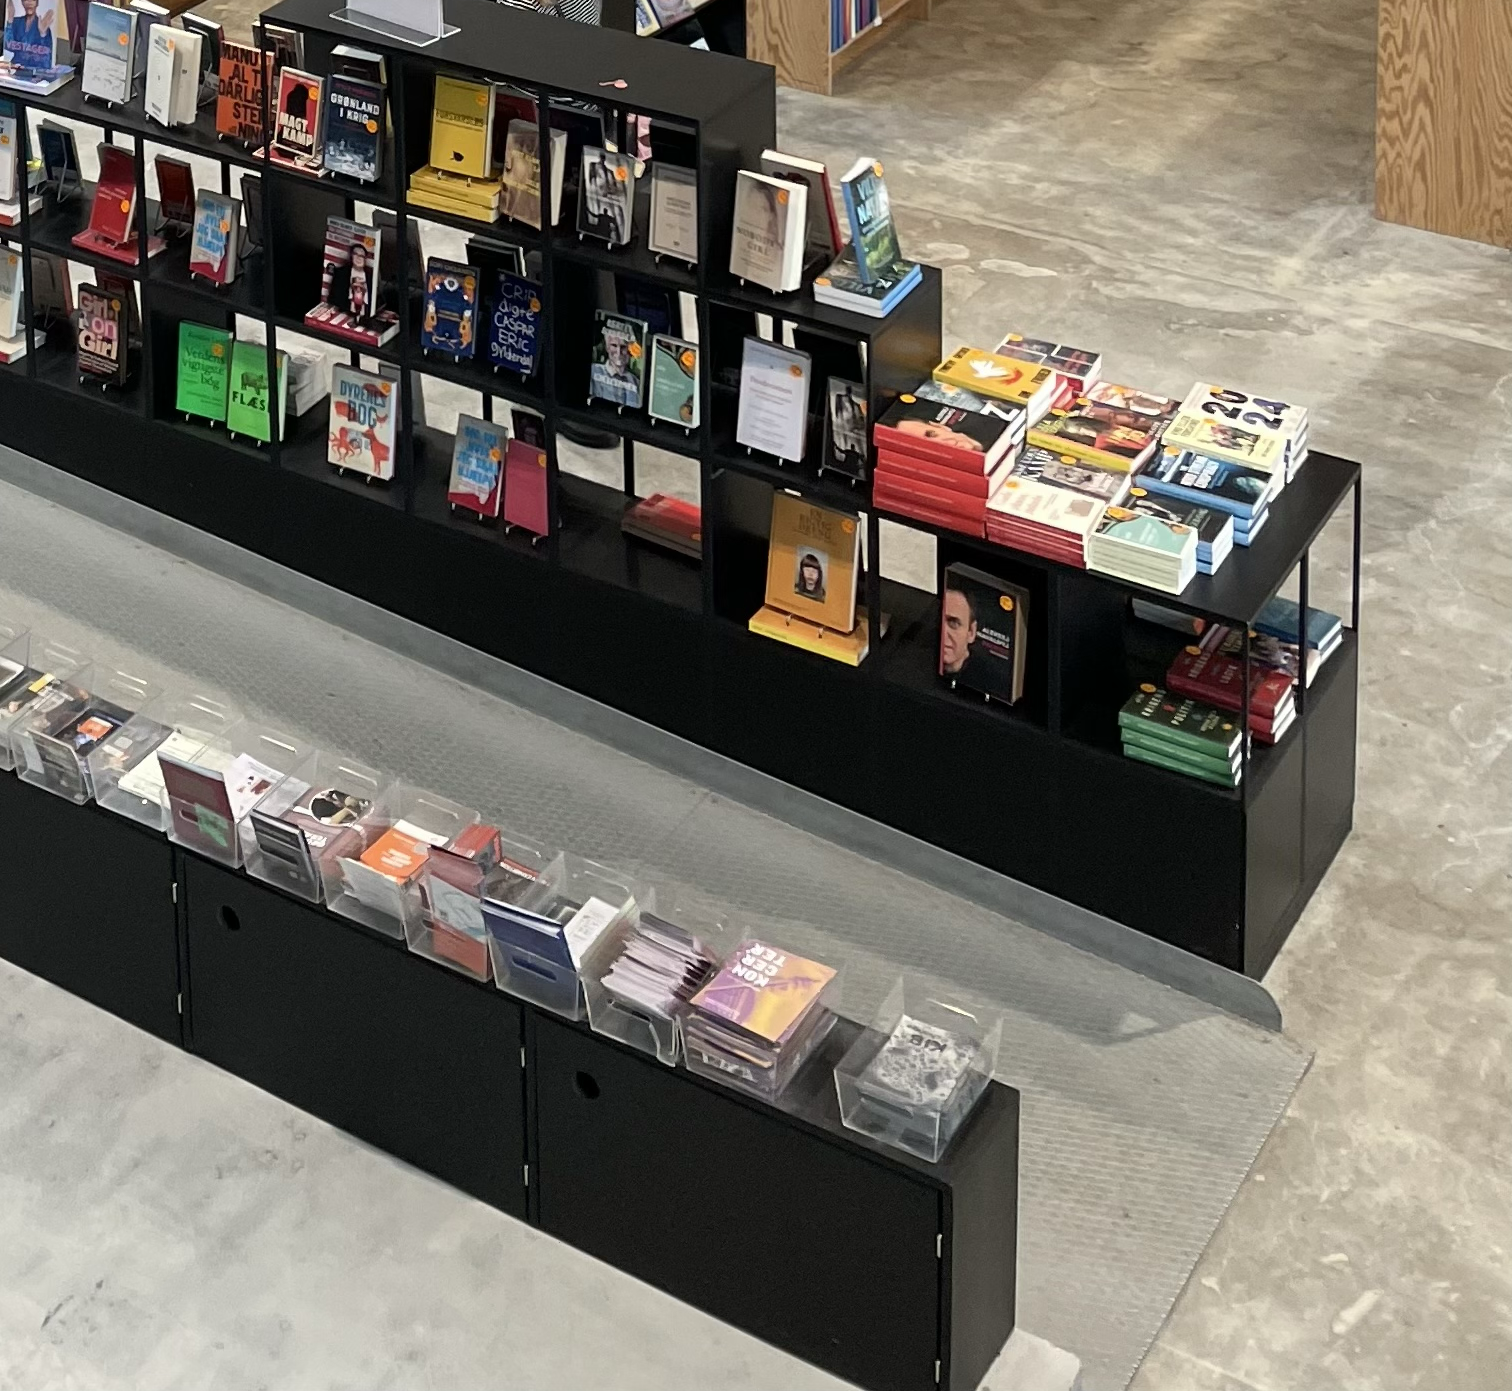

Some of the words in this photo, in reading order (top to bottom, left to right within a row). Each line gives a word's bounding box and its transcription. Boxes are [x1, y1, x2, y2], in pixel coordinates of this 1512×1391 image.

[229, 64, 249, 84] AL
[233, 101, 262, 125] STE
[330, 92, 381, 116] GRØNLAND
[279, 111, 309, 133] MAGT
[339, 108, 344, 118] I
[346, 109, 369, 125] KRIG
[237, 124, 263, 142] NIN
[282, 126, 315, 147] KAMP
[498, 298, 535, 322] digte
[91, 317, 118, 340] on
[493, 312, 536, 340] CASPAR
[79, 331, 119, 360] Girl
[185, 347, 225, 365] Verdens
[231, 390, 266, 412] FLÆS
[340, 379, 387, 408] DYRENES
[1201, 389, 1249, 420] 20
[347, 400, 378, 429] BOG
[1242, 397, 1291, 430] 24
